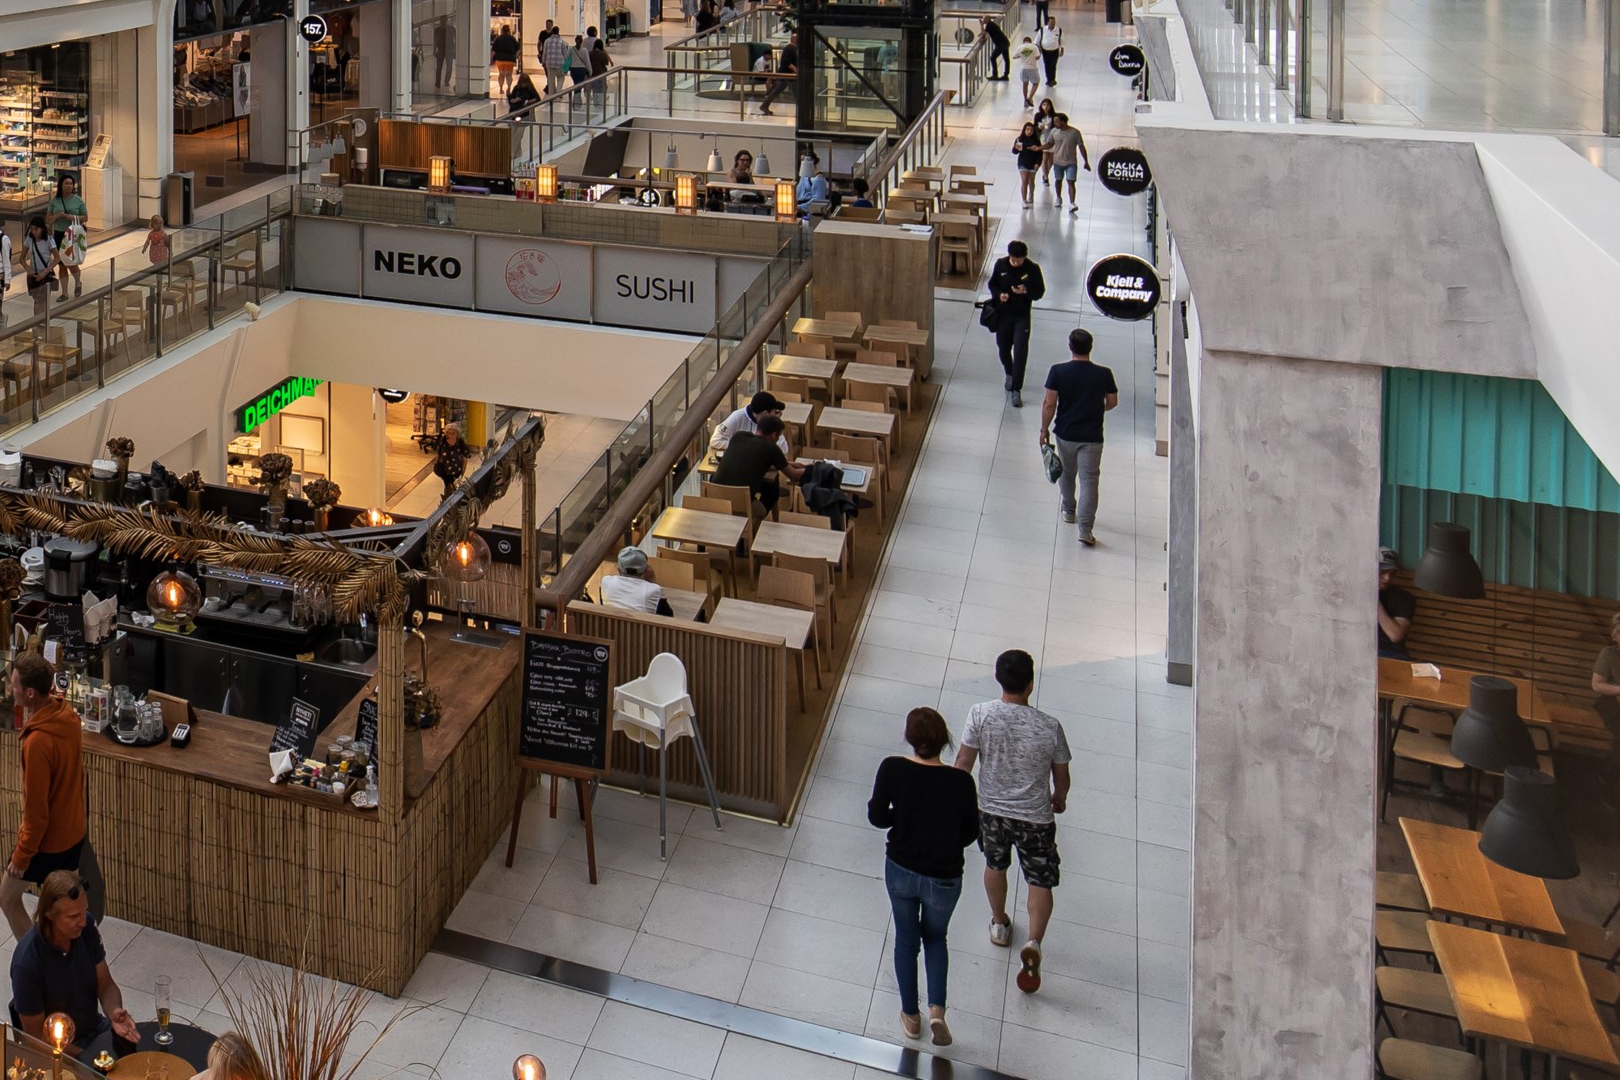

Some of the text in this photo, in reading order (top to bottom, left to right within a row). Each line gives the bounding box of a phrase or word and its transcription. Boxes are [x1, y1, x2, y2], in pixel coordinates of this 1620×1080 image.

[1107, 161, 1143, 171] NACKA
[1107, 168, 1144, 179] FORUM
[374, 249, 462, 279] NEKO
[616, 274, 694, 304] SUSHI
[1106, 275, 1144, 289] Kjell &
[1095, 286, 1153, 303] Company
